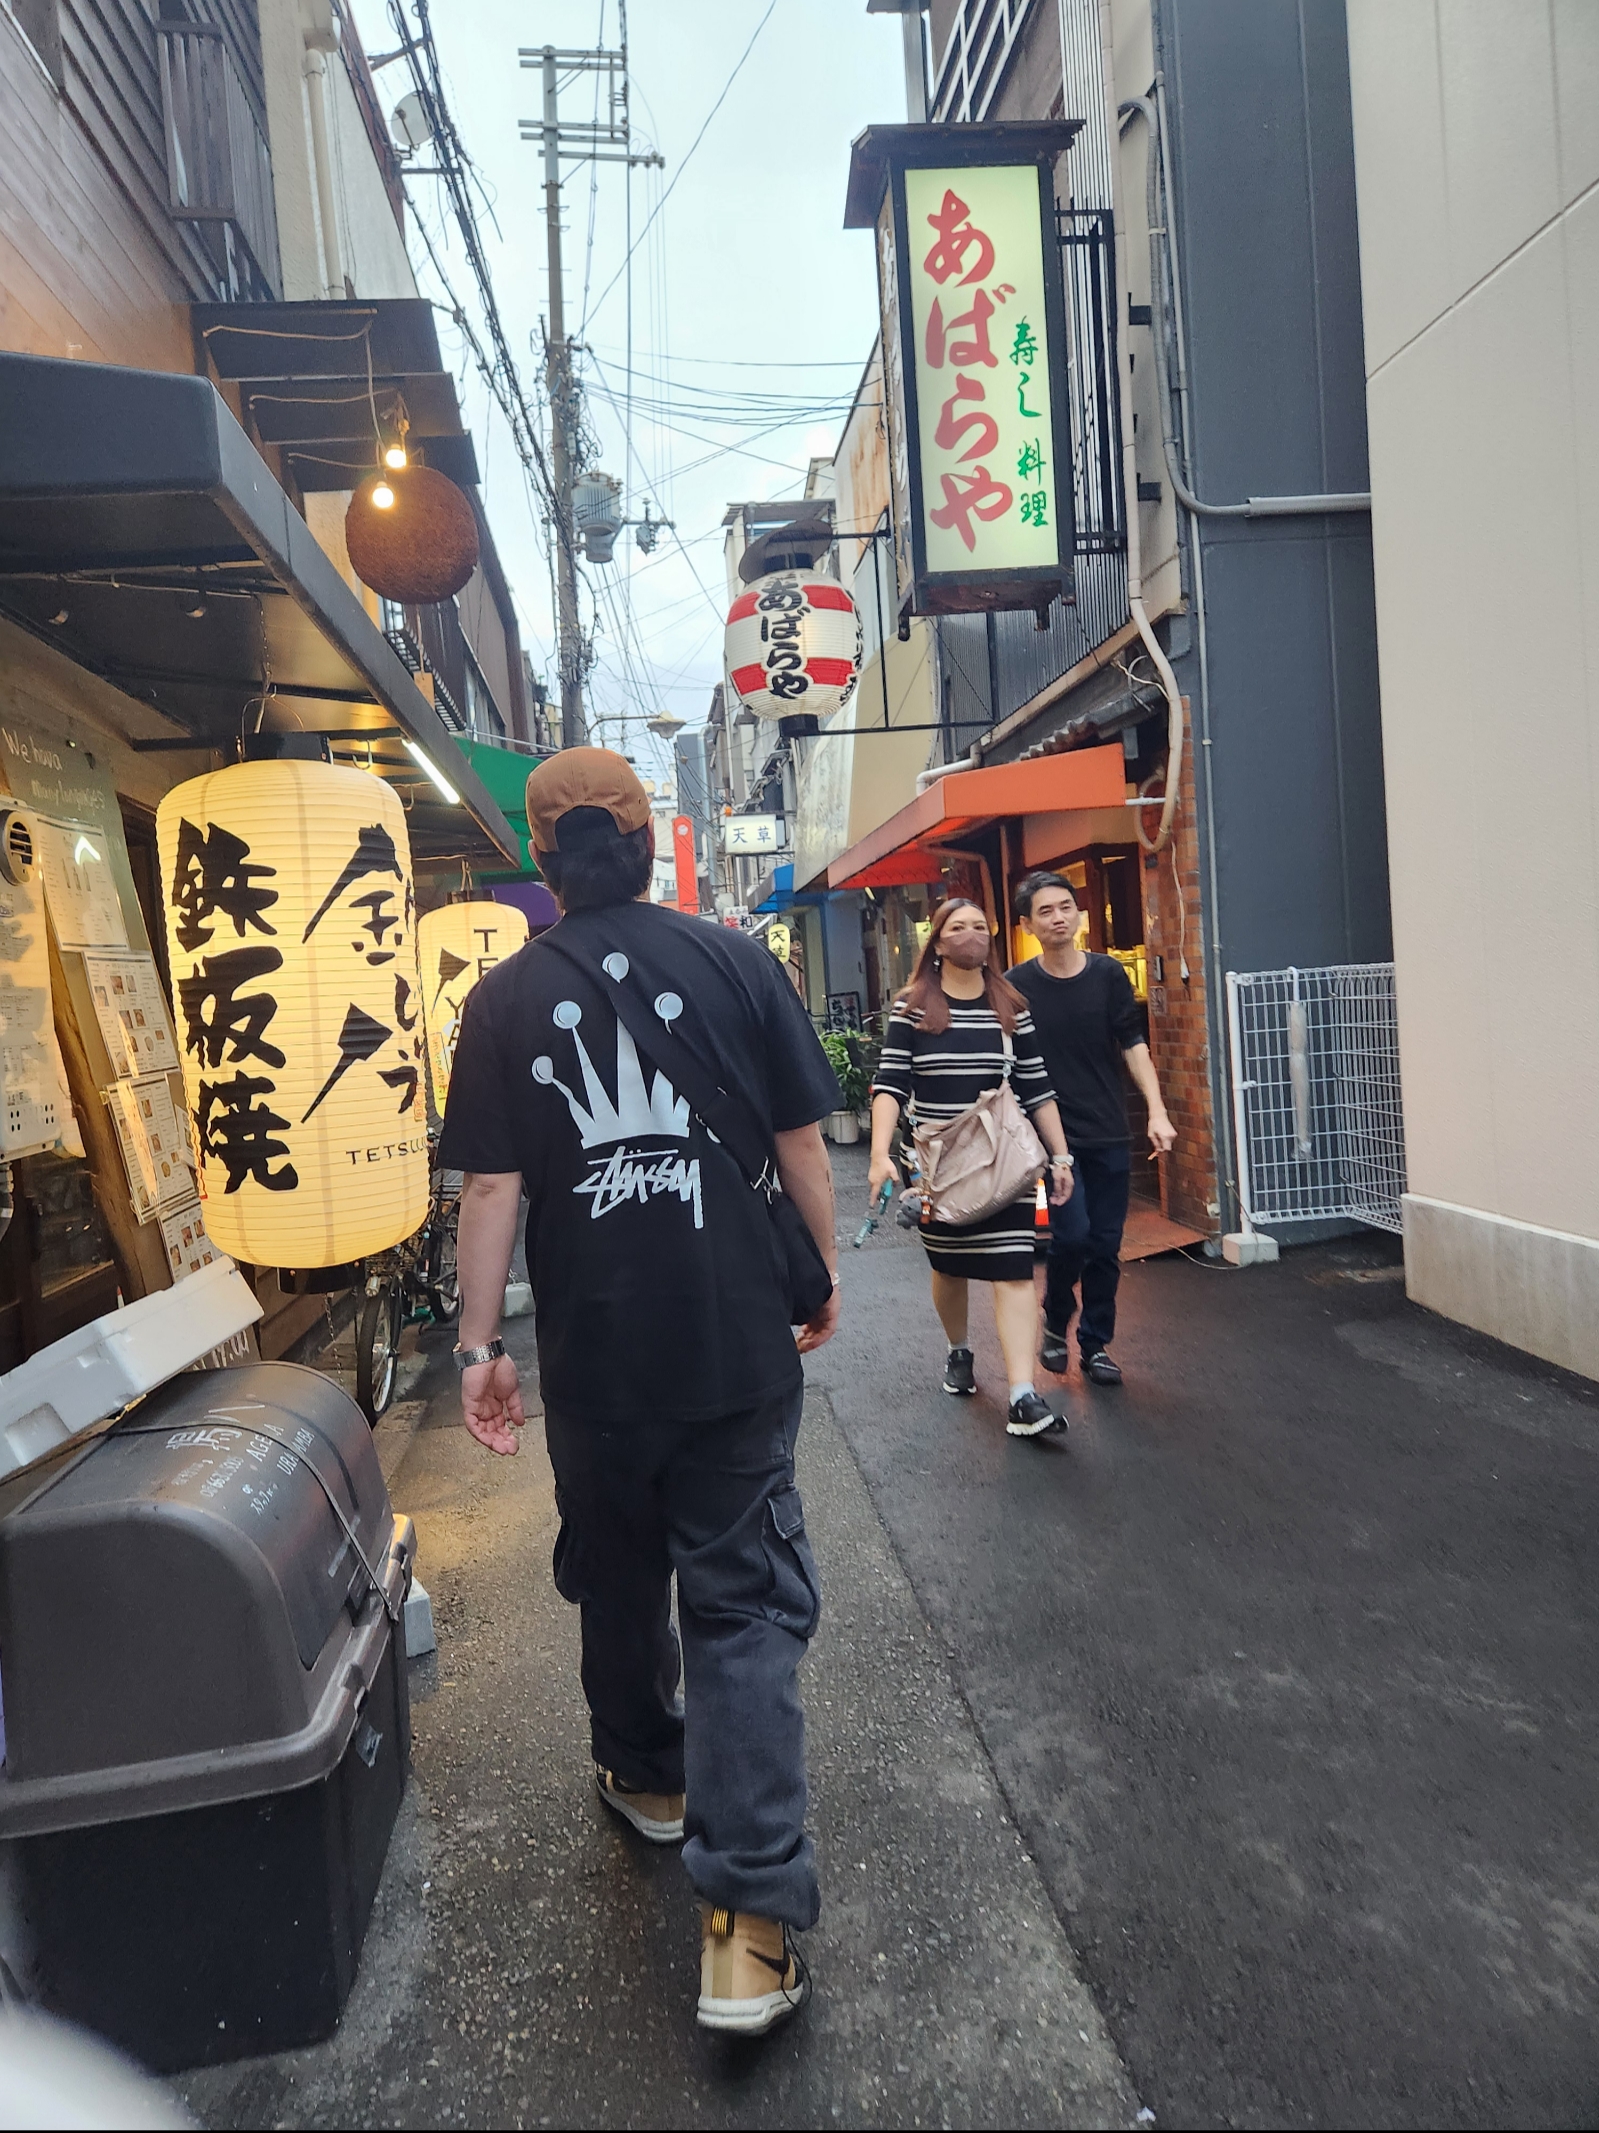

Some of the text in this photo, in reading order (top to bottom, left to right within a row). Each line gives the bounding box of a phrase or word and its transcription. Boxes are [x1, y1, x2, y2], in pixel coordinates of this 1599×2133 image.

[923, 189, 1016, 553] あばらや
[758, 580, 811, 700] あばらや
[2, 727, 31, 763] We
[732, 826, 771, 844] 天草
[246, 1423, 285, 1462] AGEA
